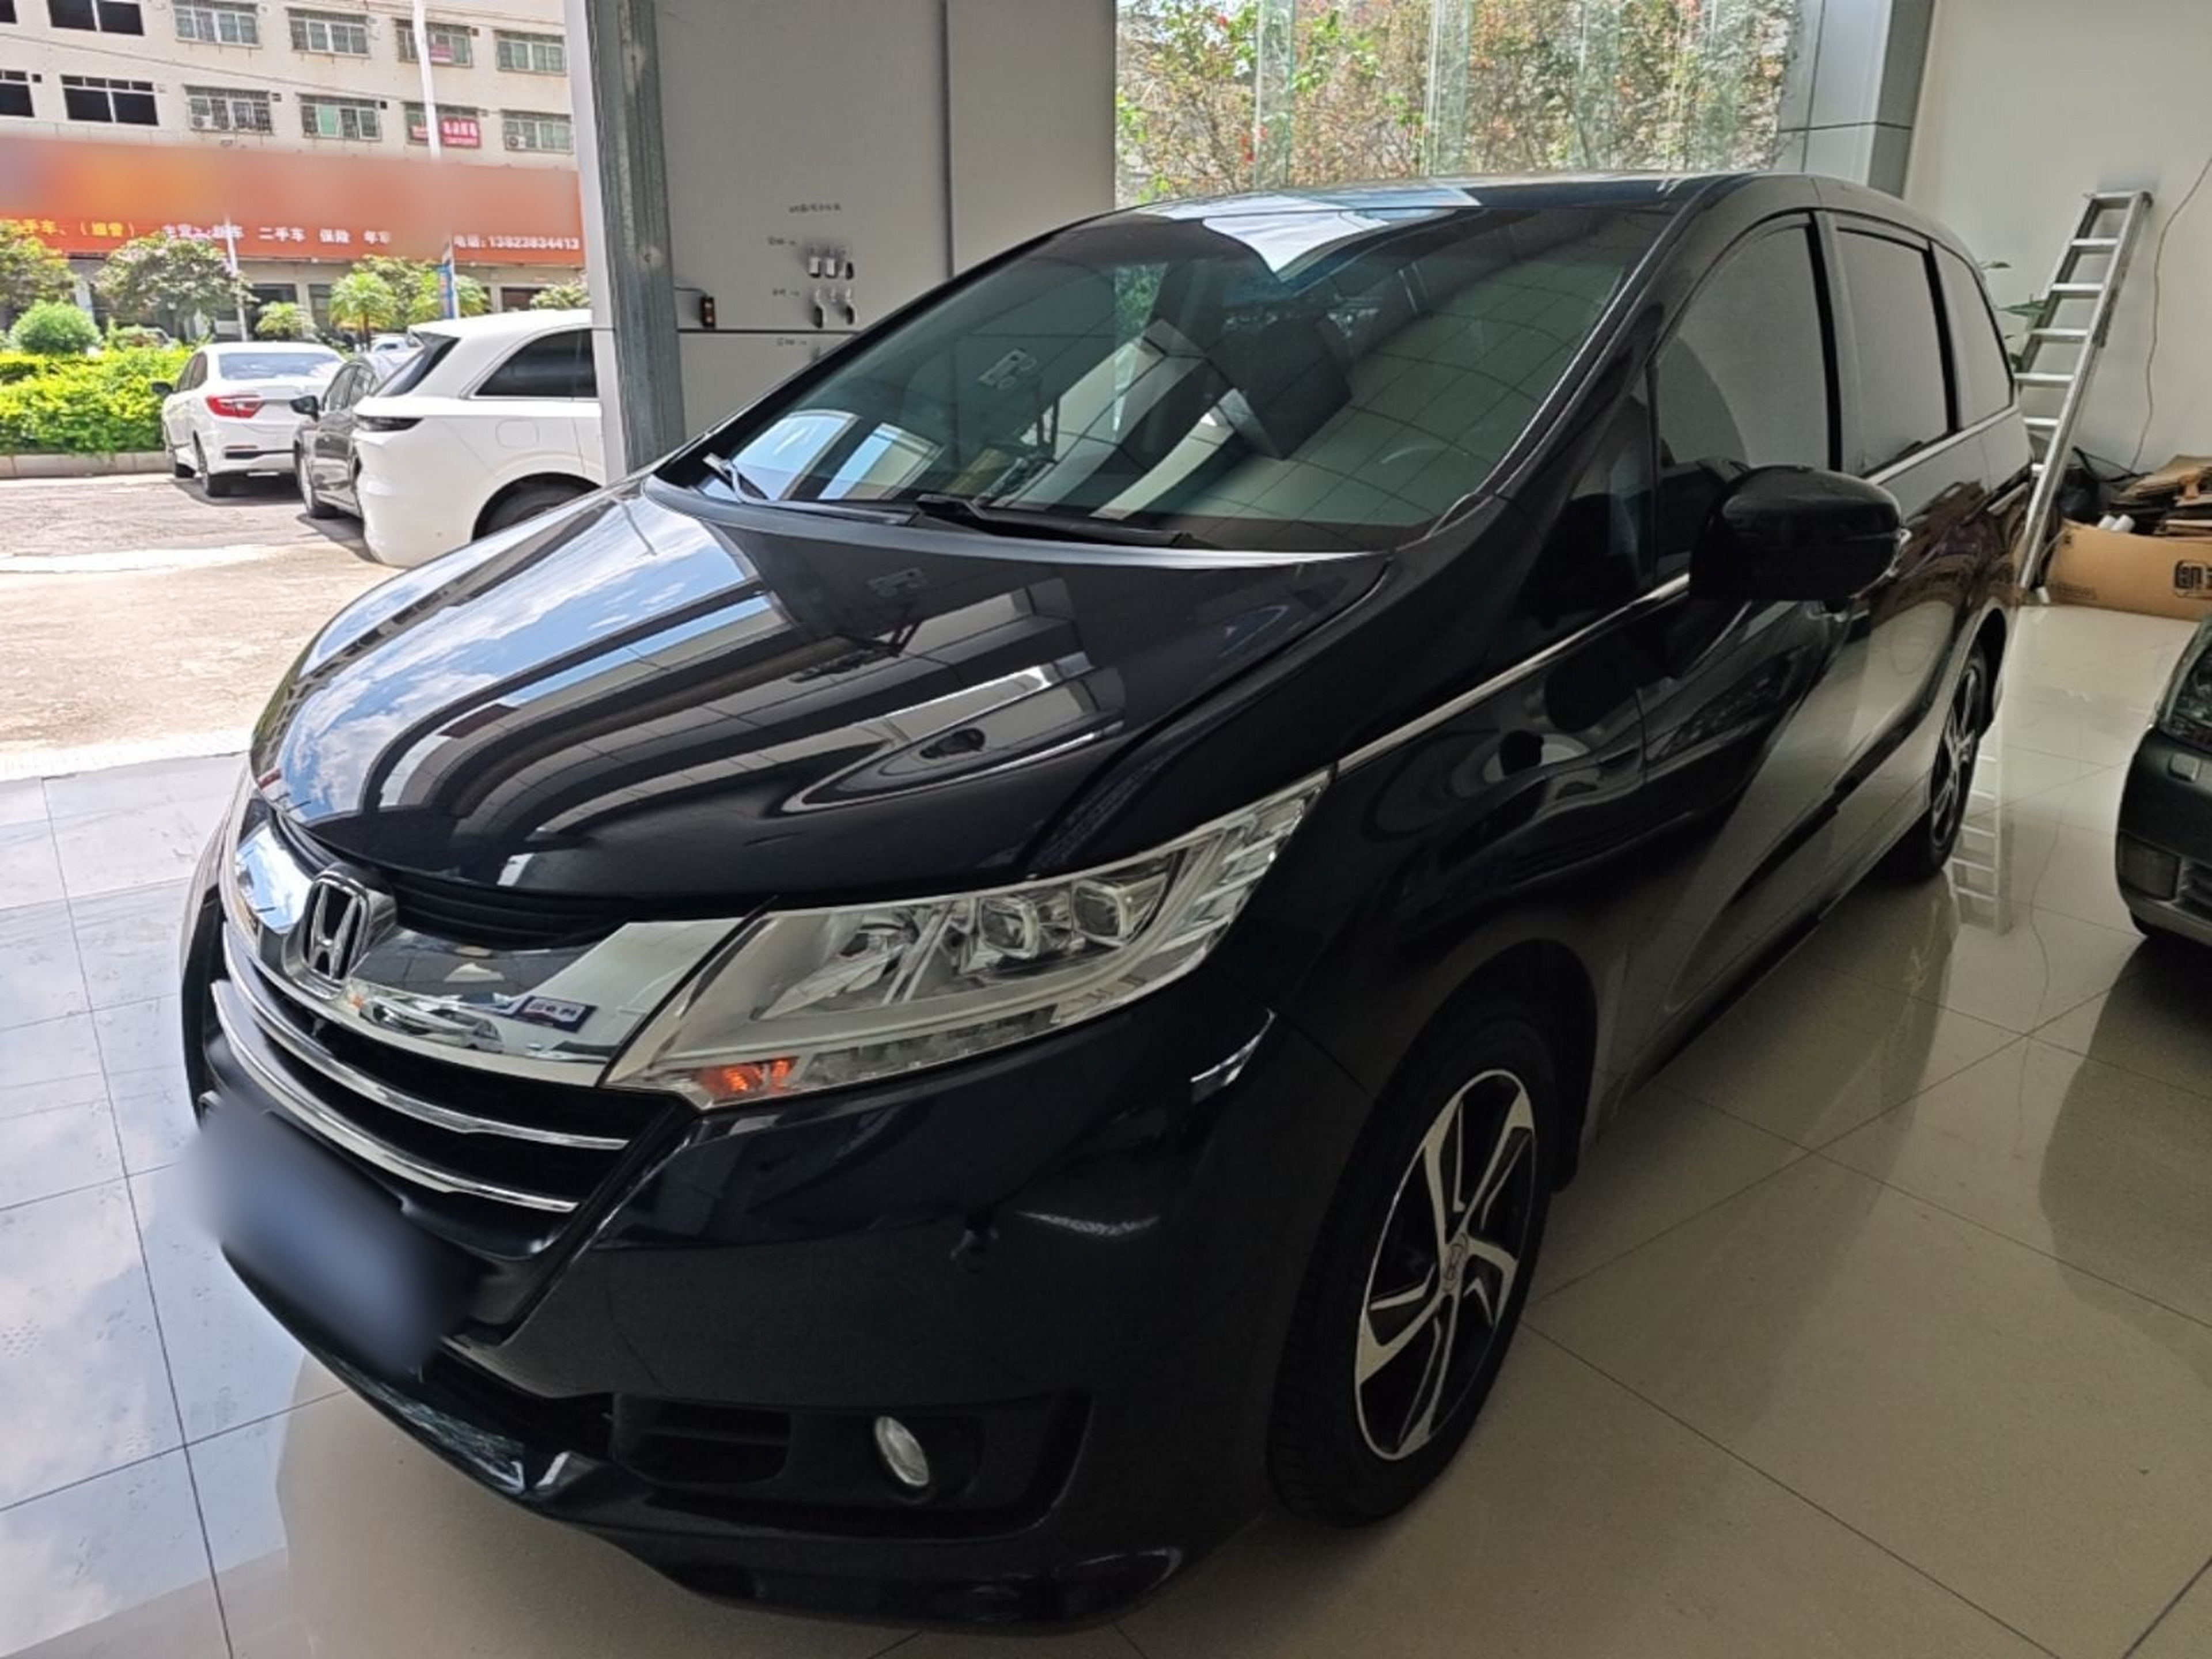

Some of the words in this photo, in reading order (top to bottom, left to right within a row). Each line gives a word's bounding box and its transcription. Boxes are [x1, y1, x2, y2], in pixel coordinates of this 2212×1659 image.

[259, 226, 305, 242] 二手车
[320, 228, 350, 244] 保险
